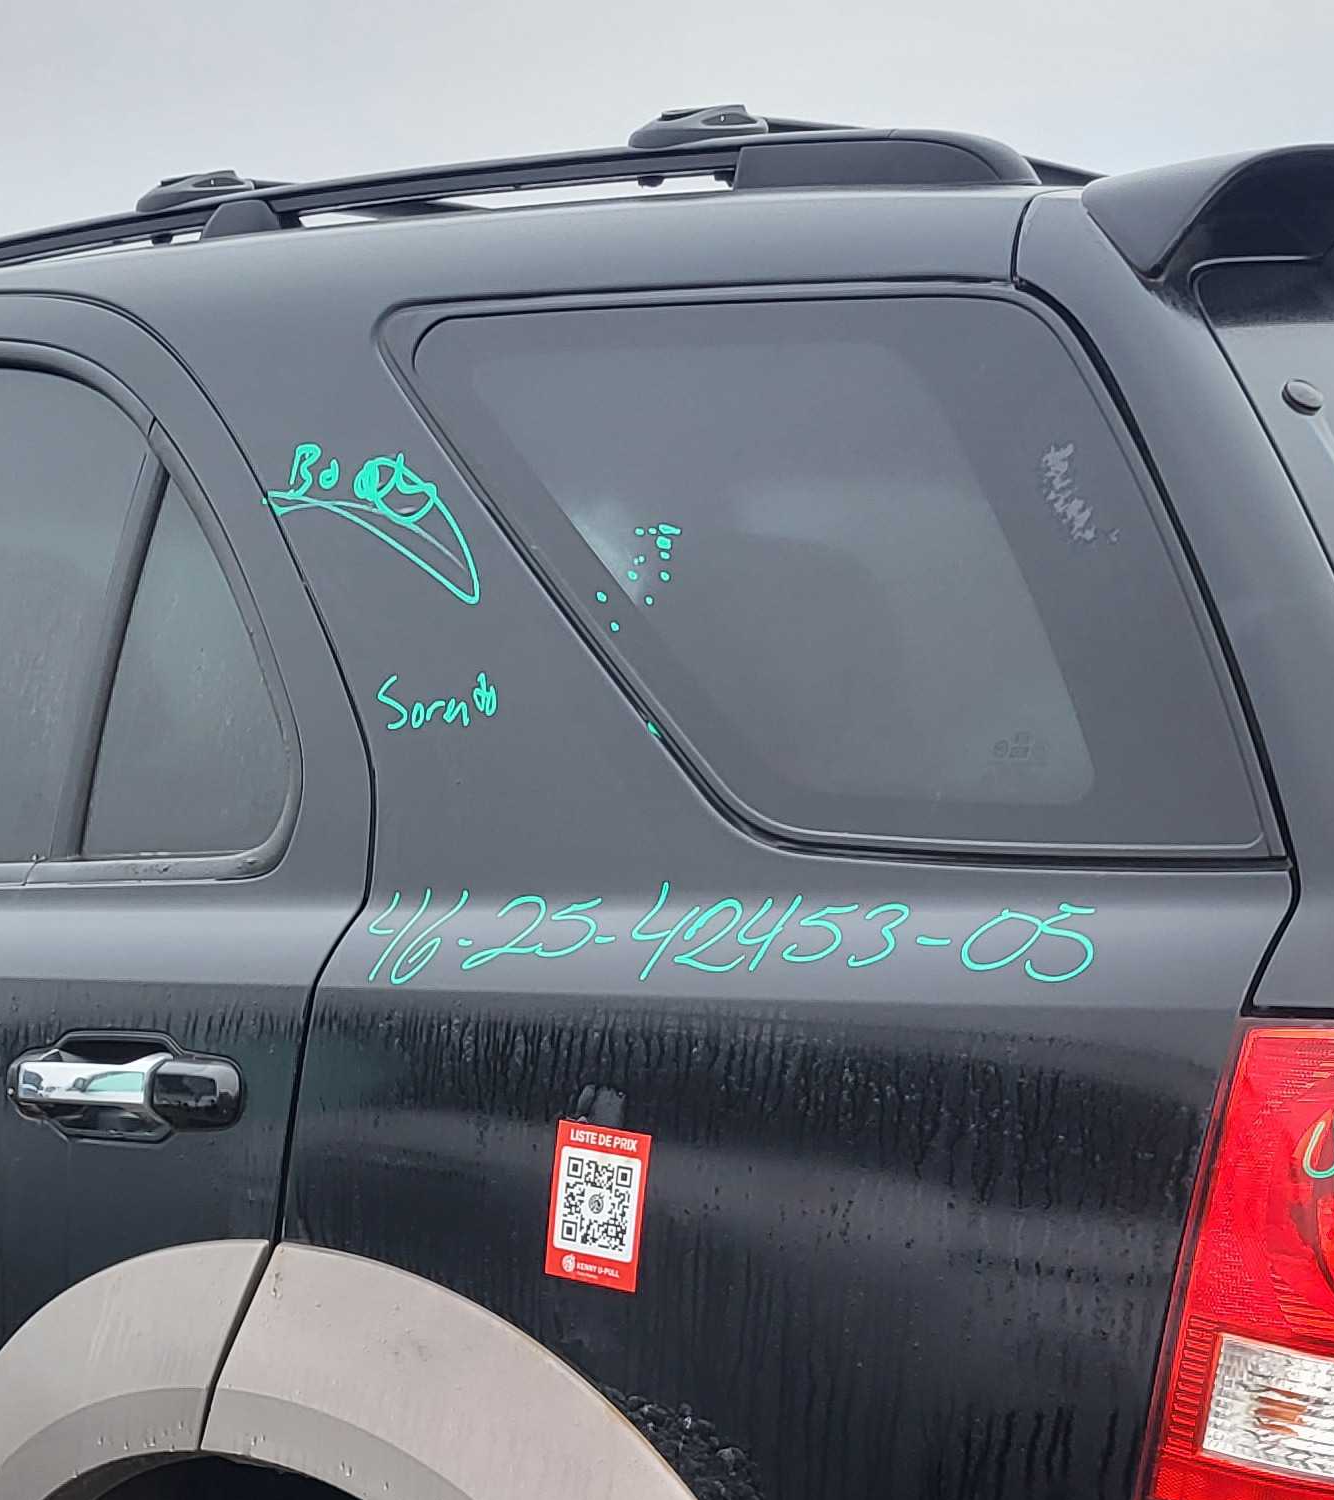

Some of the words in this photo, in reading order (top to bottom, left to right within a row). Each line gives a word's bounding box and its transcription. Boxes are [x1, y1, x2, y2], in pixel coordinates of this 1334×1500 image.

[366, 880, 1096, 986] 46-25-42453-05
[570, 1128, 597, 1145] LISTE
[598, 1132, 613, 1148] DE
[612, 1136, 638, 1153] PRIX
